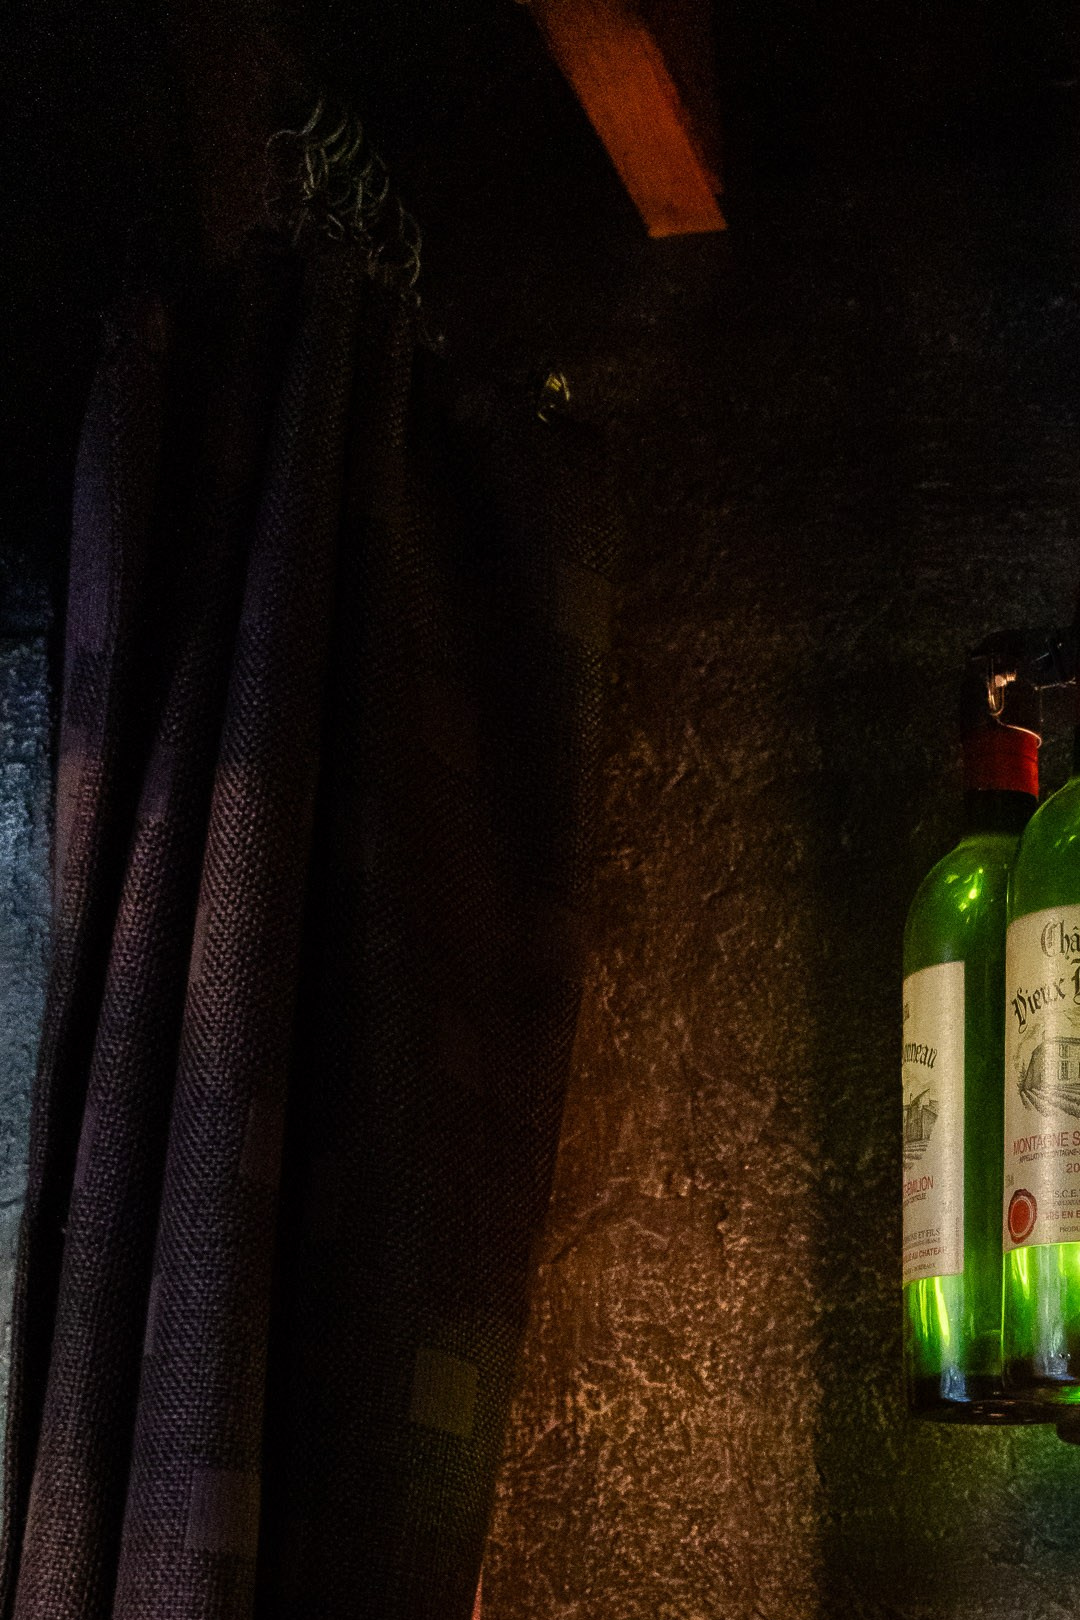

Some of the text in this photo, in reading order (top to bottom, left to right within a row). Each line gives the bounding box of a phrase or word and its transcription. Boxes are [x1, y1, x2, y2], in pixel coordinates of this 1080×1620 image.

[1012, 977, 1066, 1034] Vieux
[1013, 1132, 1069, 1157] MONTAGNE
[1061, 1210, 1073, 1219] EN
